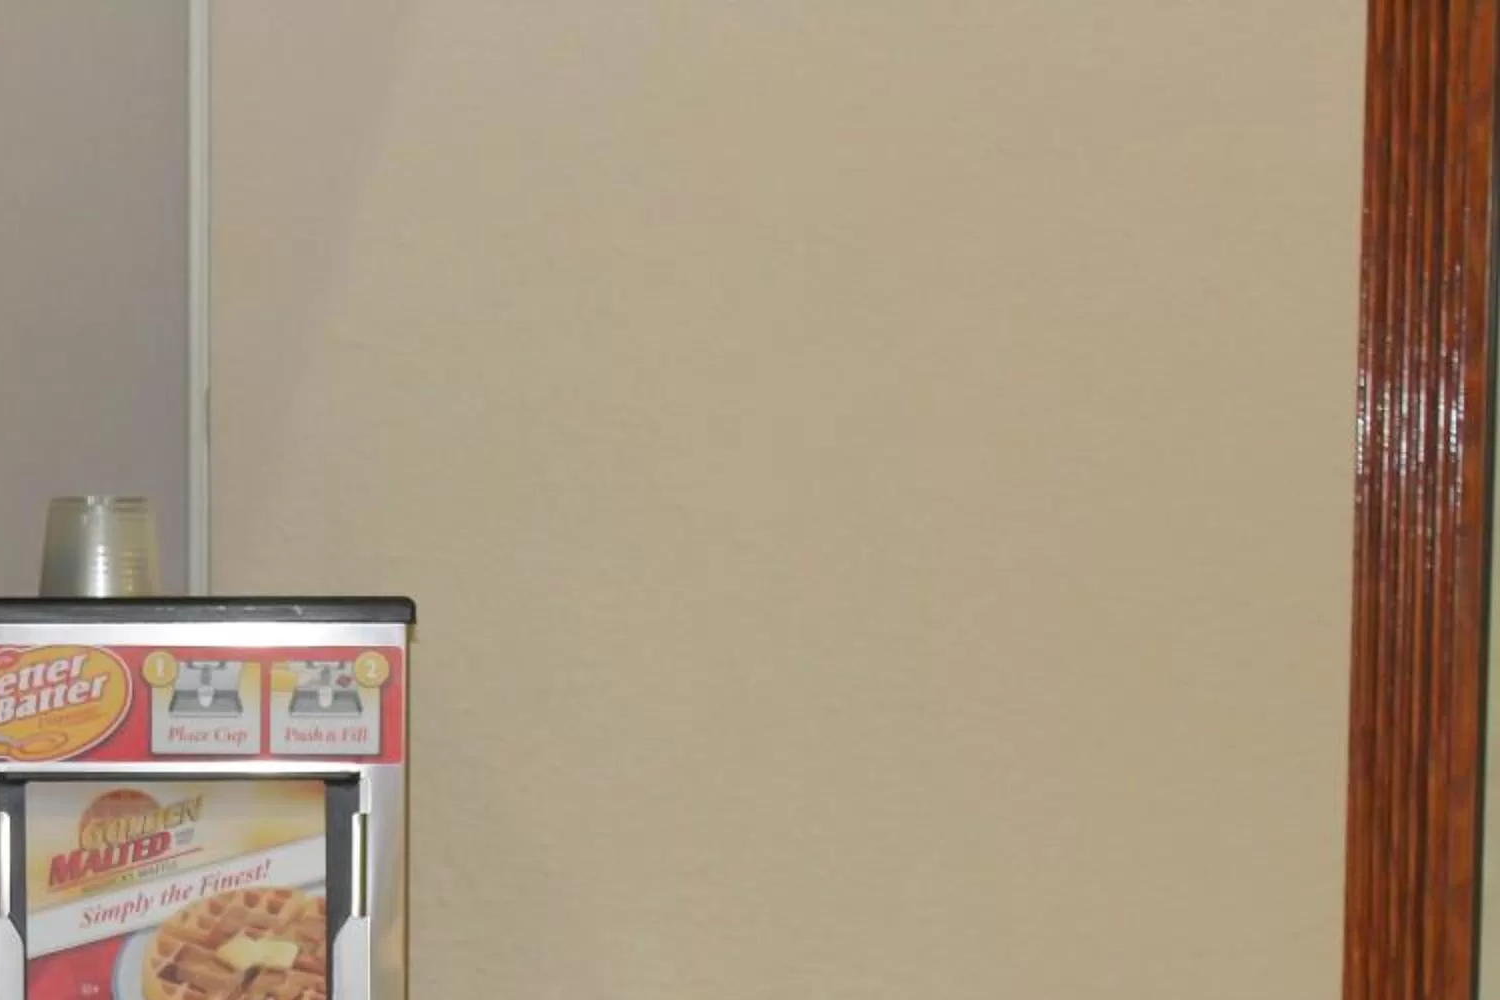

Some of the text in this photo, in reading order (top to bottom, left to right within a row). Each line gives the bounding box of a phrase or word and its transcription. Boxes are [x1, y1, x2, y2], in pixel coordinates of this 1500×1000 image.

[155, 658, 166, 679] 1
[365, 658, 377, 679] 2
[168, 726, 248, 746] Place Cup
[284, 726, 321, 743] Push
[340, 727, 368, 743] Fill
[49, 831, 172, 887] MALTED
[79, 893, 155, 930] Simply
[160, 879, 193, 908] the
[199, 858, 272, 898] Finest!
